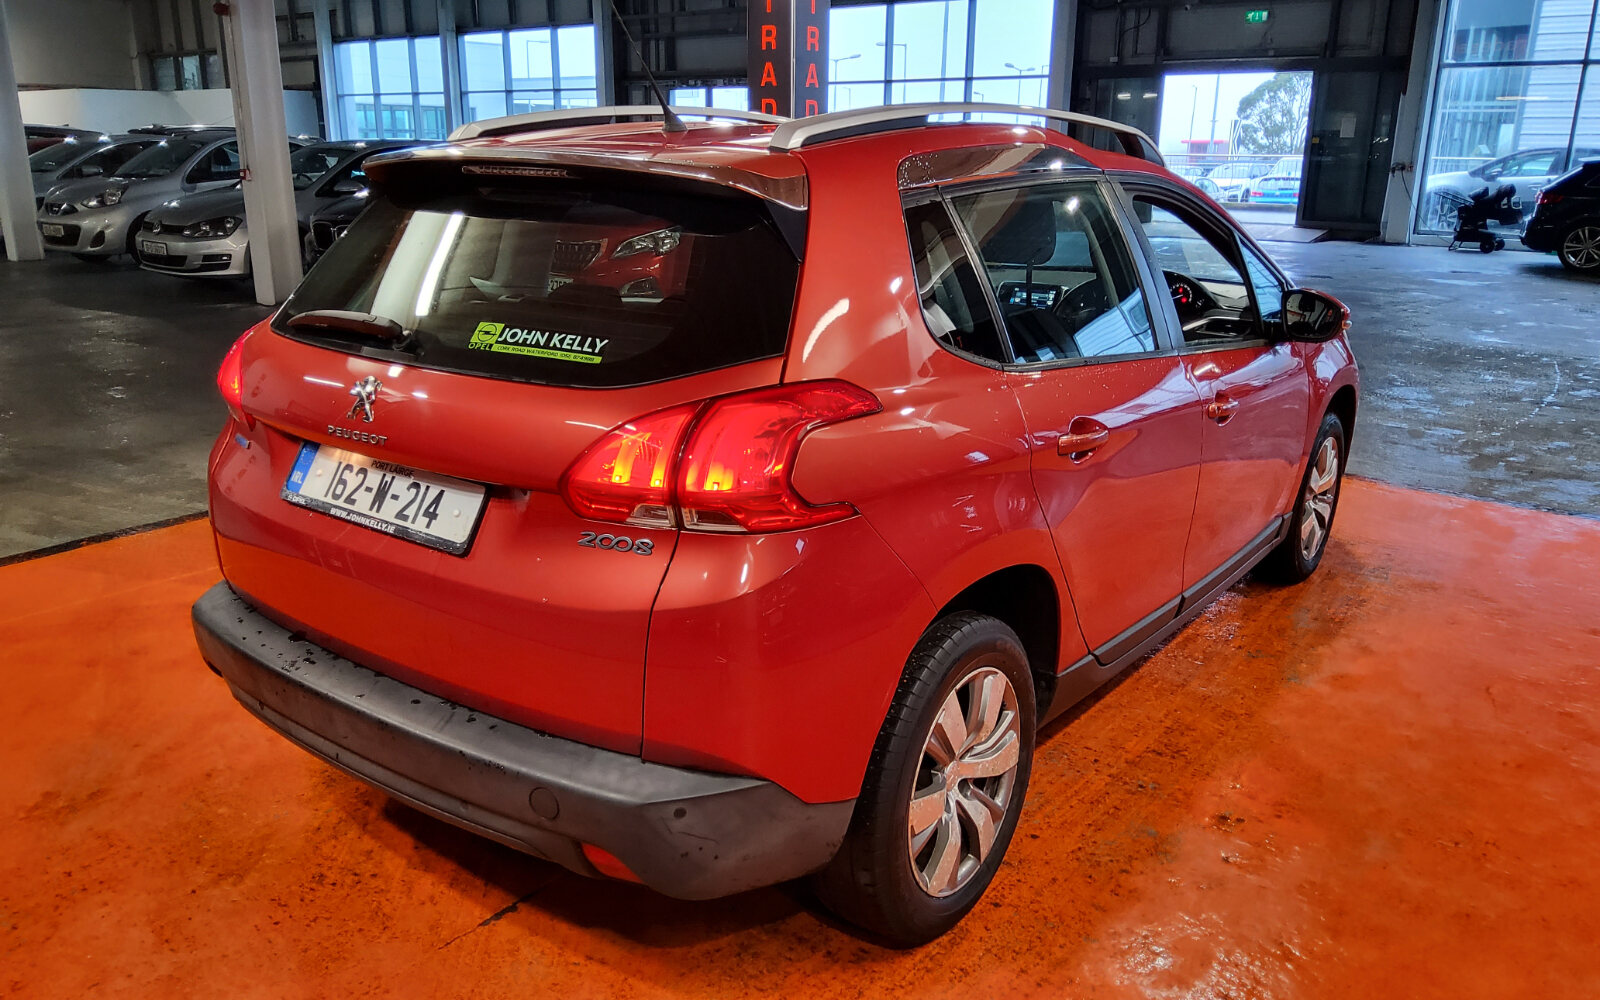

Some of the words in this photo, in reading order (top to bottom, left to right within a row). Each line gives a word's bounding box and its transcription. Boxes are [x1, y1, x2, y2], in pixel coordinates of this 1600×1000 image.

[468, 342, 492, 351] OPEL
[498, 328, 549, 346] JOHN
[549, 332, 610, 353] KELLY
[526, 348, 559, 357] WATERFORD
[327, 424, 388, 445] PEUGEOT
[371, 460, 389, 471] PORT
[290, 470, 304, 484] IRL
[324, 461, 445, 529] 162-W-214
[330, 507, 397, 534] WWW.JOHNKELLY.IE
[577, 531, 655, 556] 2008
